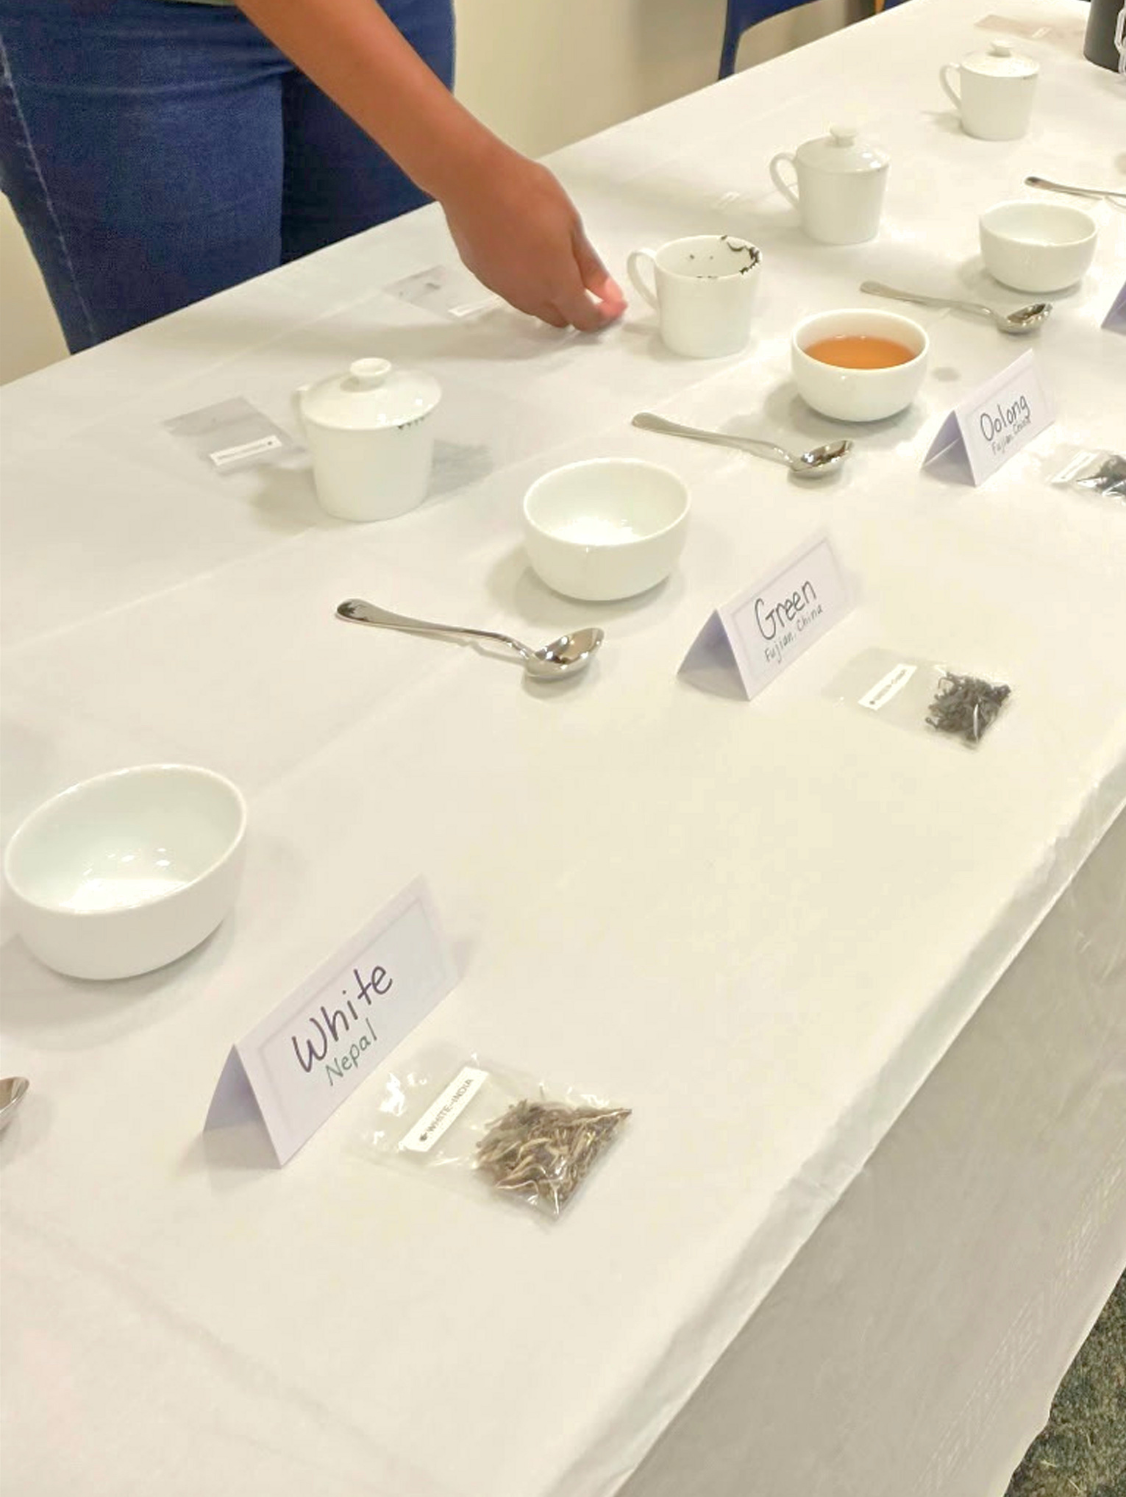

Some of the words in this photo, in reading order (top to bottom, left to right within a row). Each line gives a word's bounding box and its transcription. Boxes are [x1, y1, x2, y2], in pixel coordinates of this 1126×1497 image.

[980, 395, 1031, 442] Oolong
[754, 580, 817, 641] Green
[796, 604, 822, 632] China
[292, 965, 393, 1073] White
[325, 1017, 377, 1087] Nepal
